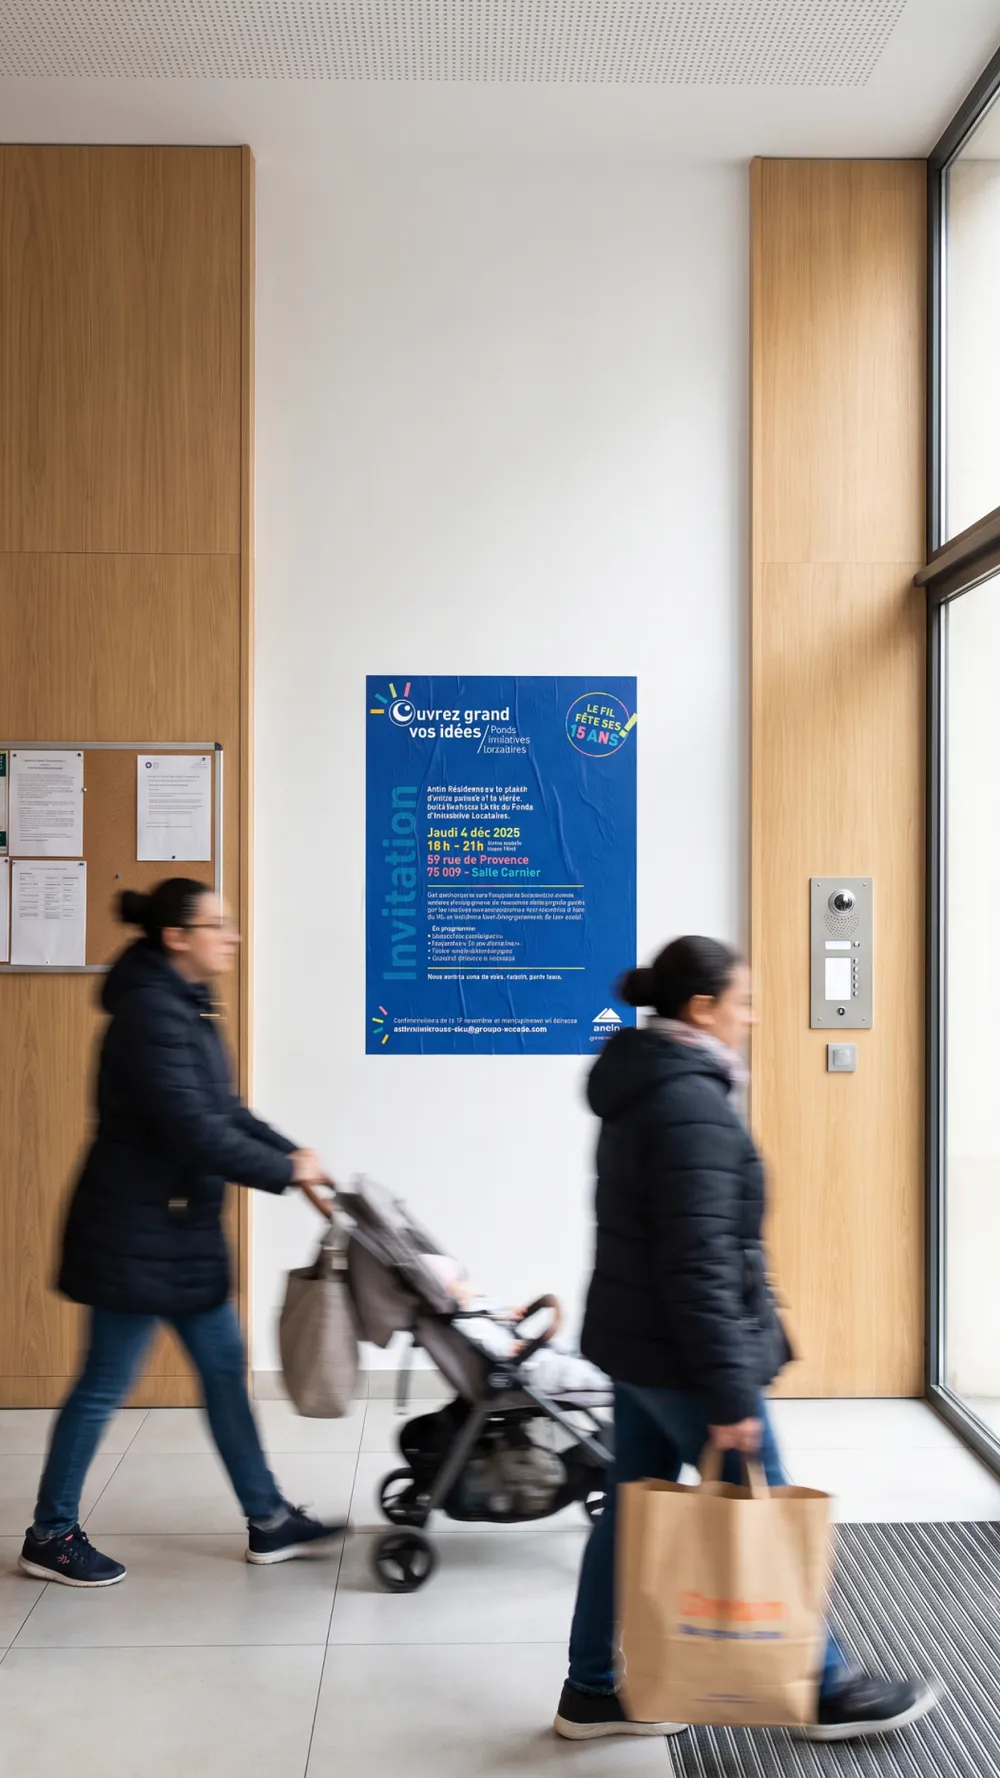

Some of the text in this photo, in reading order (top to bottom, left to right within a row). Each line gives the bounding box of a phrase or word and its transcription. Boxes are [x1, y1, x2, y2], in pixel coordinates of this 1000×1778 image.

[464, 706, 509, 724] grand
[587, 704, 615, 718] LE FIL
[575, 712, 621, 731] FÊTE SES
[409, 723, 482, 738] vos idées
[570, 723, 586, 740] 15
[427, 785, 446, 793] Antin
[501, 803, 510, 811] du
[427, 825, 520, 838] Jaudi 4 déc 2025
[427, 840, 441, 851] 18
[427, 854, 529, 865] 59 rue de Provence
[427, 867, 440, 878] 75
[442, 867, 461, 878] 009
[472, 867, 498, 878] Salle
[501, 867, 541, 878] Carnier
[381, 786, 417, 979] Invitation
